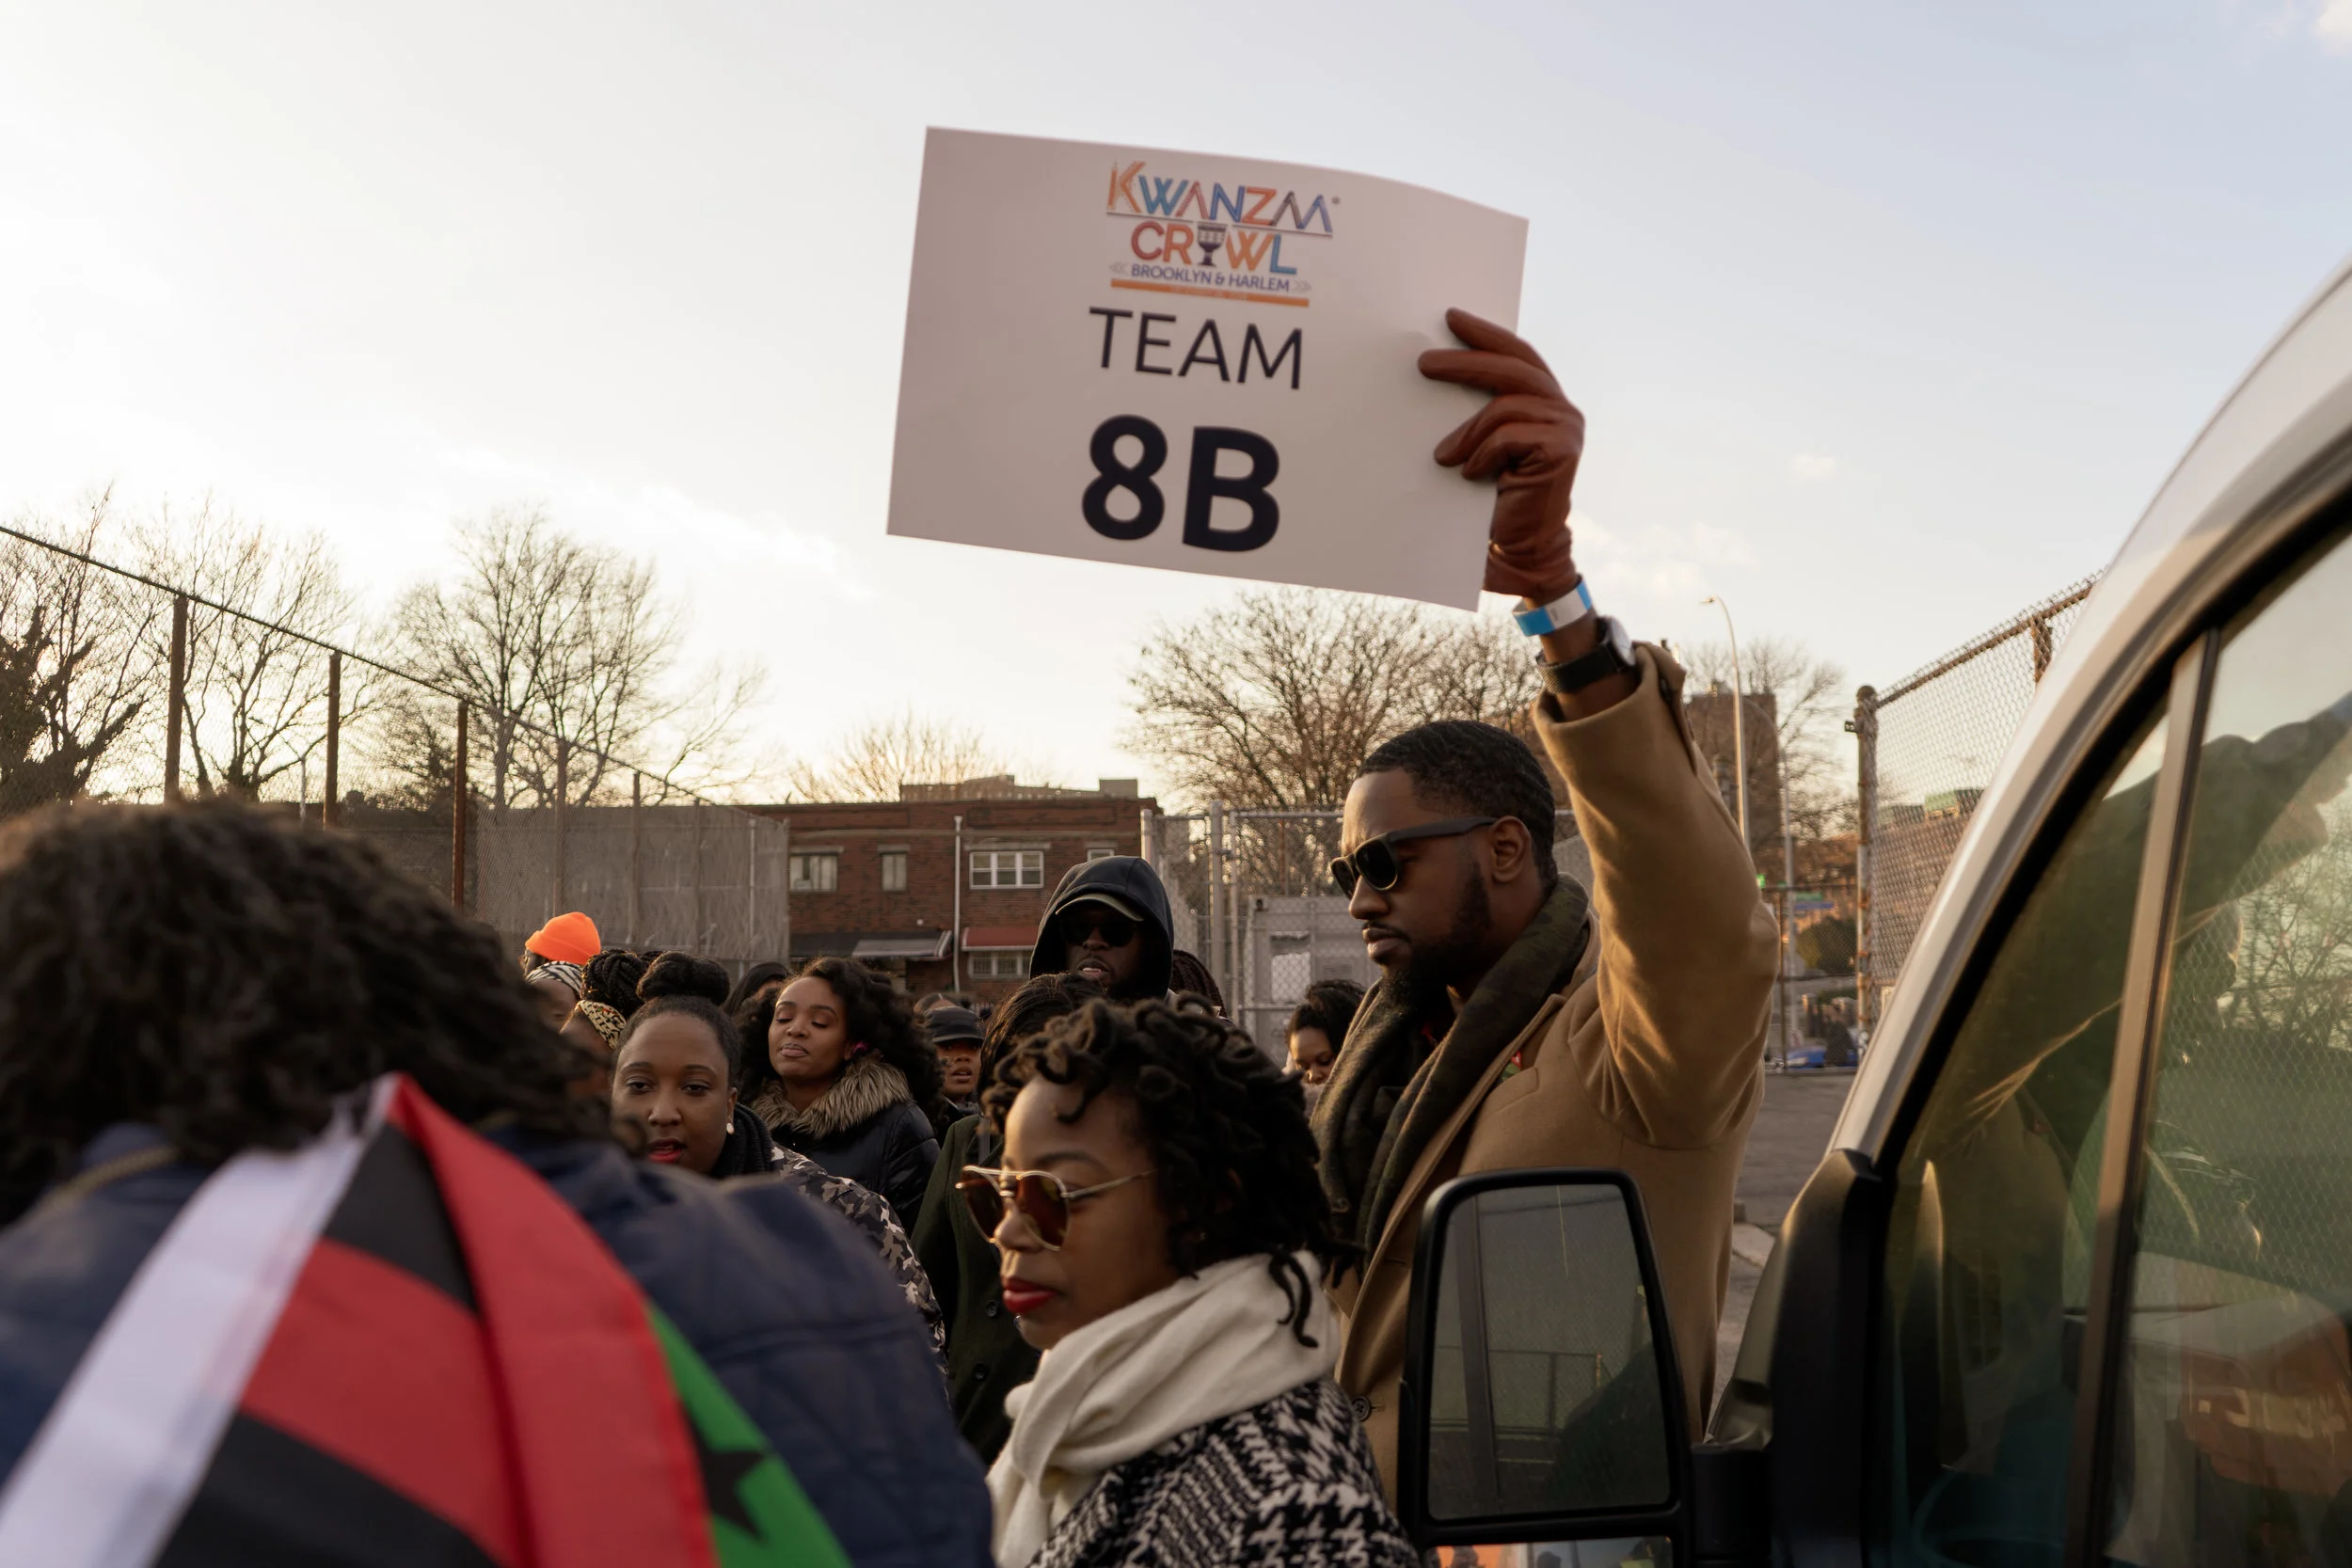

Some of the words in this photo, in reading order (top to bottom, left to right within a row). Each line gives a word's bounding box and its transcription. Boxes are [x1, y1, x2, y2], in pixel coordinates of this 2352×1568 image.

[1107, 160, 1333, 233] KWANZAA
[1131, 263, 1212, 284] BROOKLYN
[1215, 273, 1226, 286] &
[1229, 274, 1290, 293] HARLEM
[1089, 306, 1302, 390] TEAM
[1082, 414, 1280, 552] 8B
